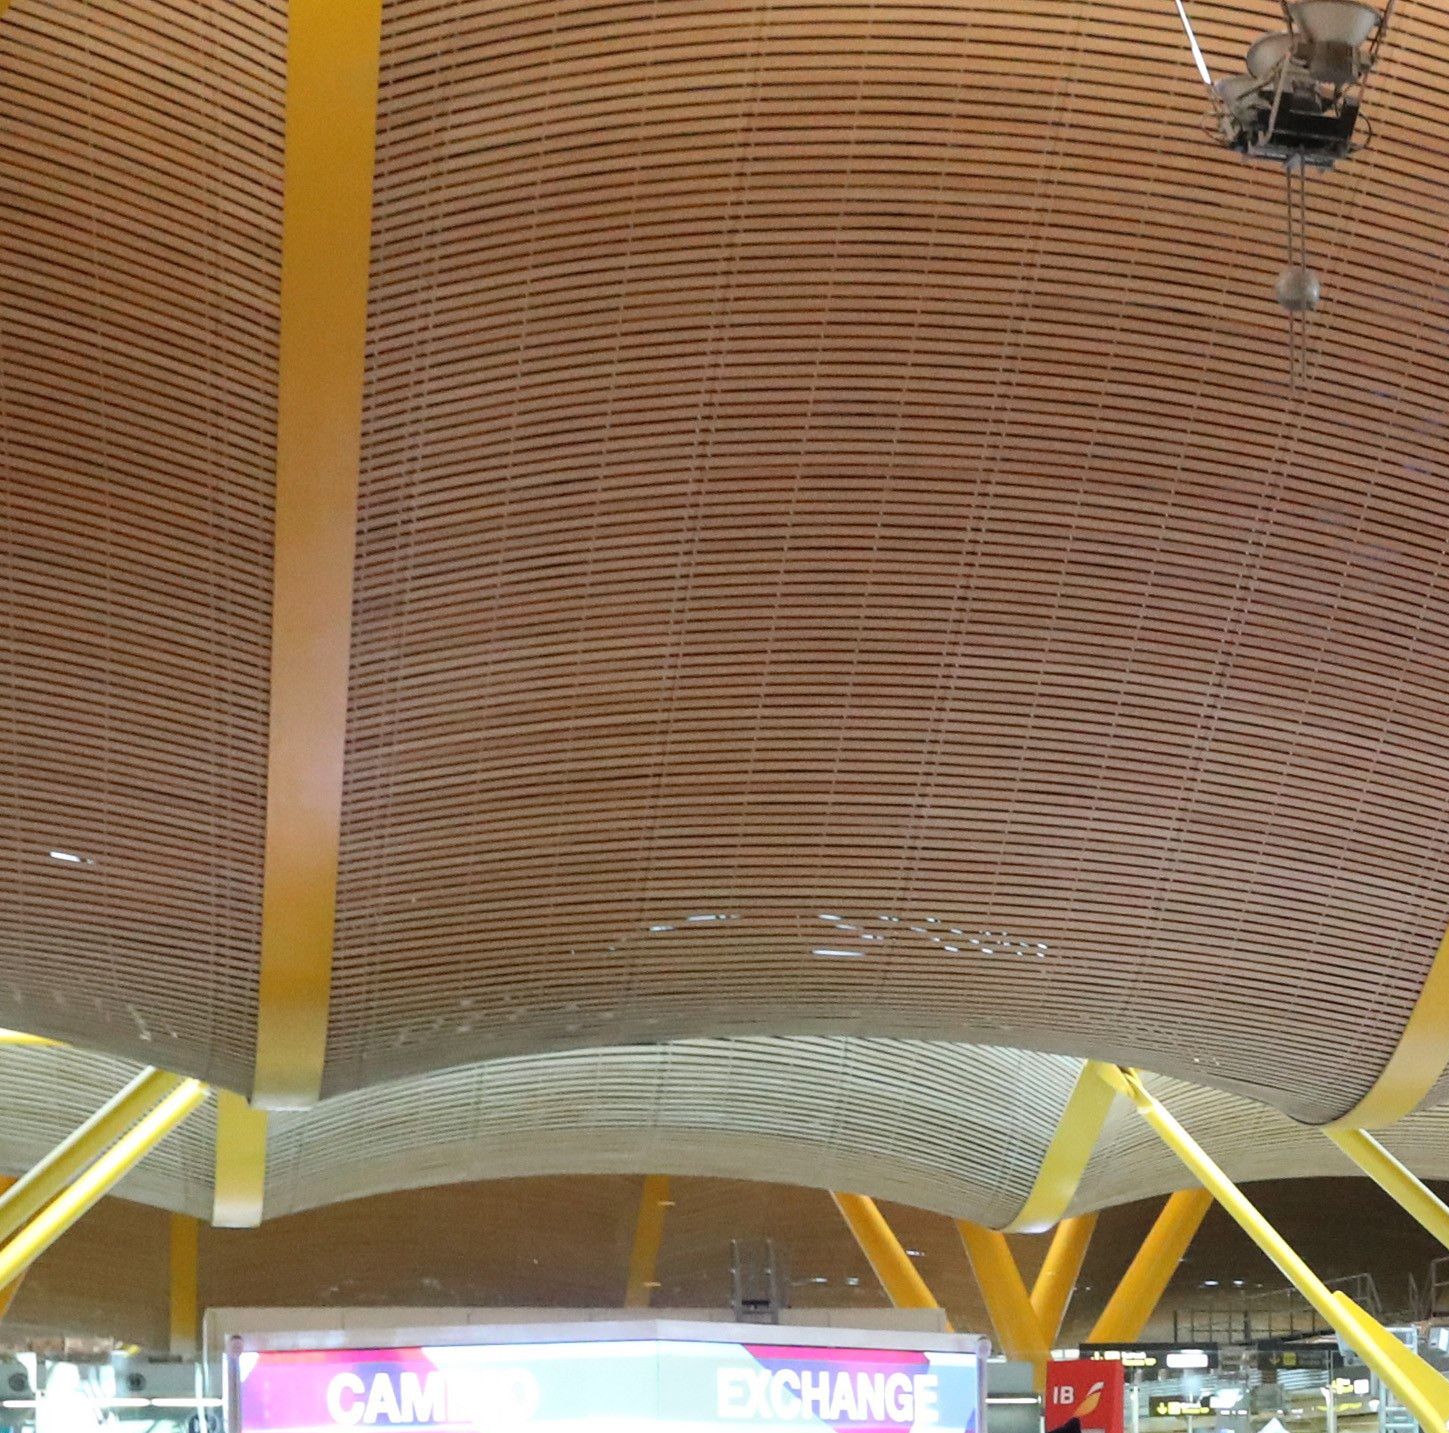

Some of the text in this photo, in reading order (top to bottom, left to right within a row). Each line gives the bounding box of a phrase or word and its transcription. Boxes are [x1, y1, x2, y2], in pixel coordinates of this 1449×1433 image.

[326, 1371, 541, 1426] CAMO
[717, 1368, 939, 1425] EXCHANGE
[1053, 1386, 1075, 1405] IB
